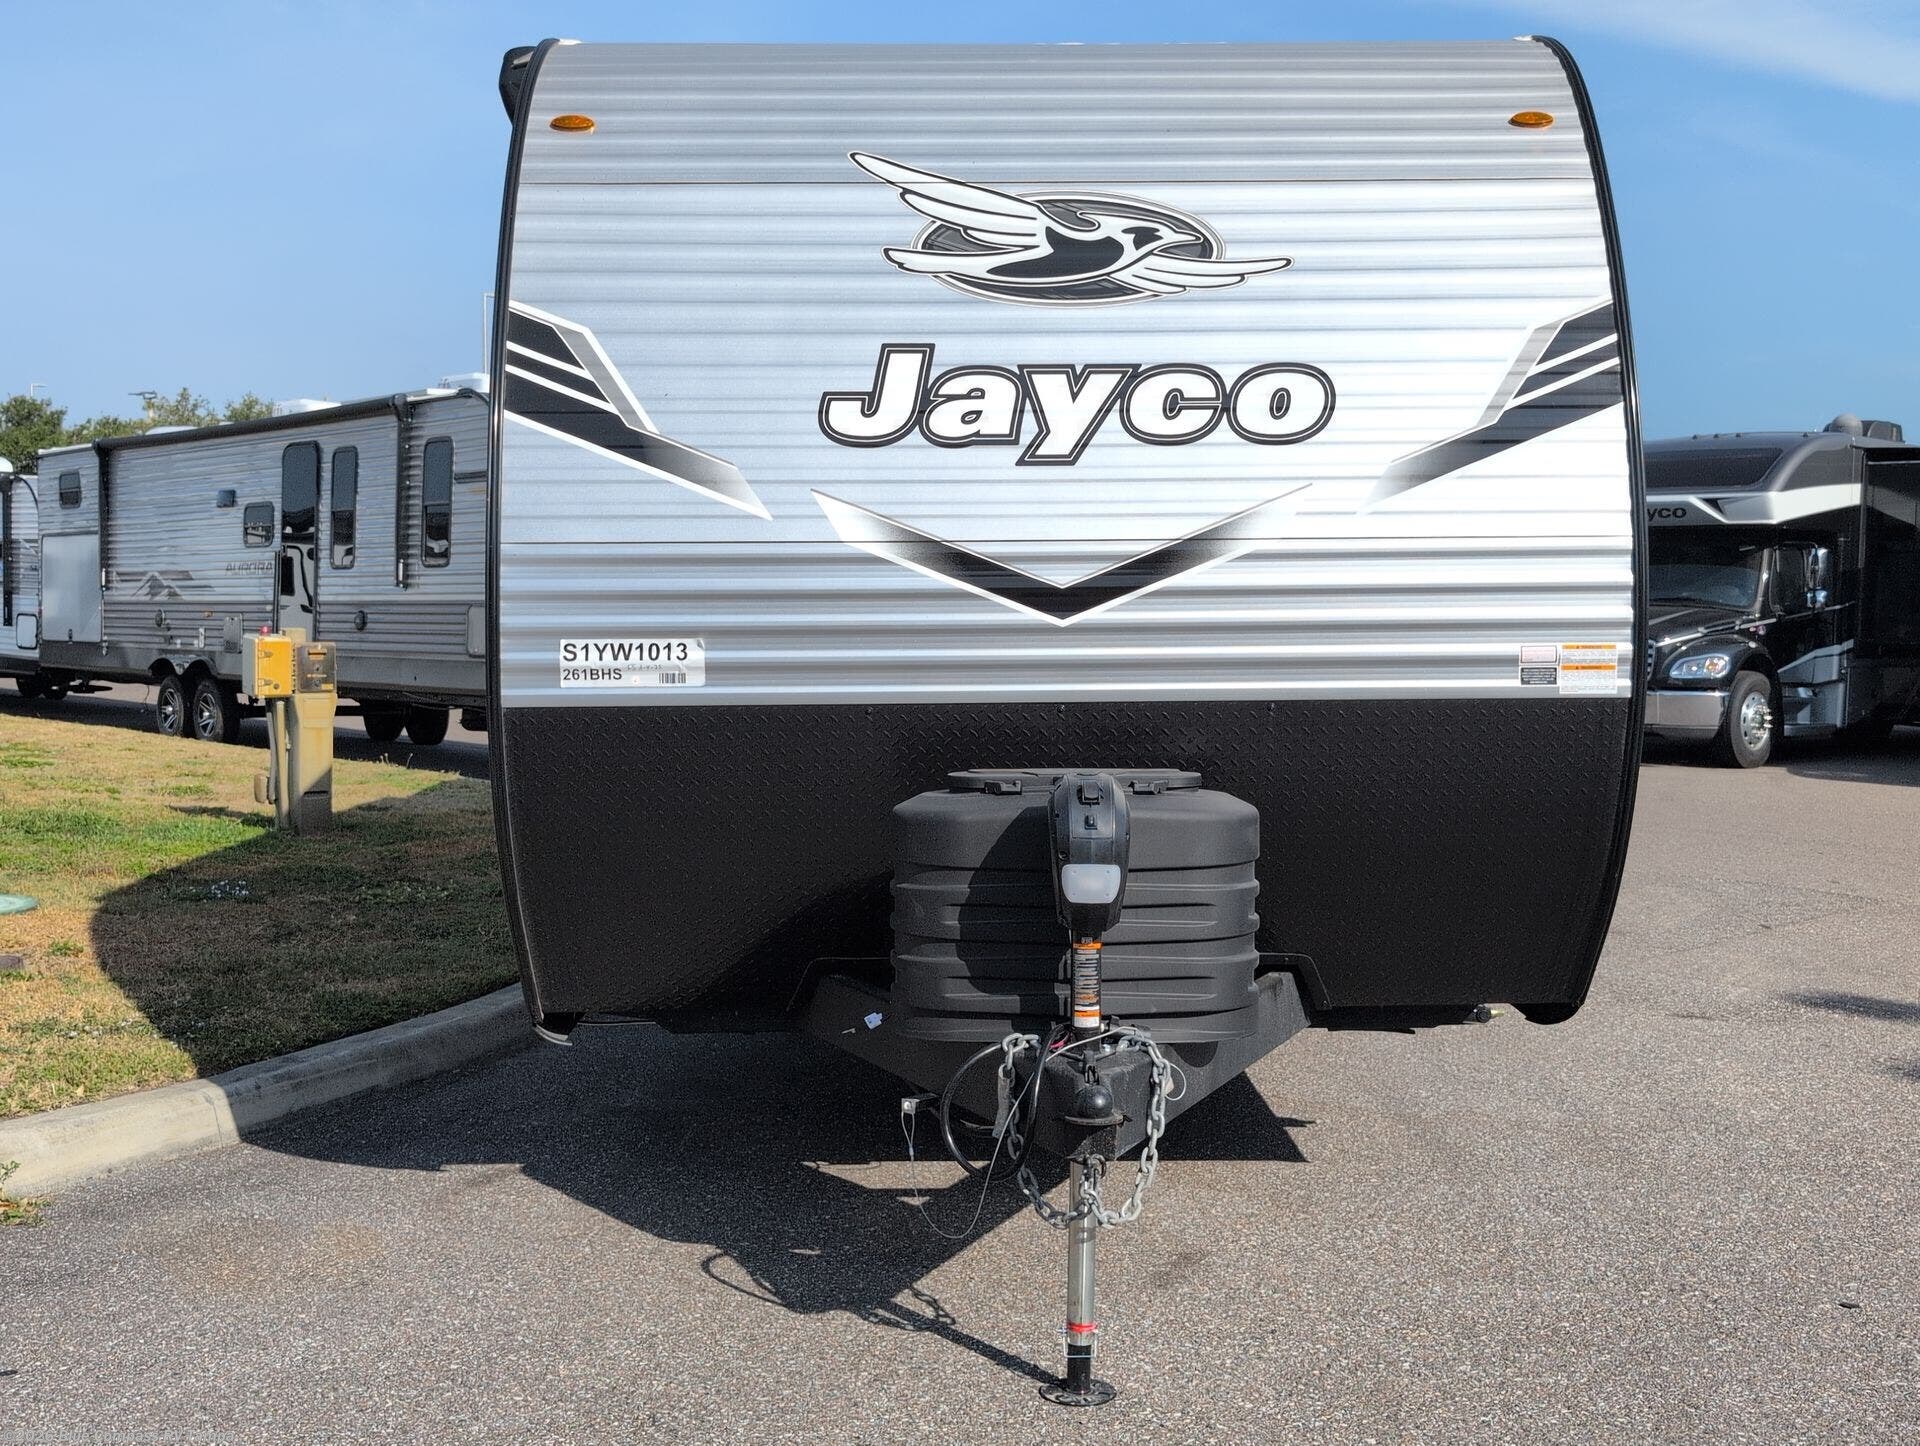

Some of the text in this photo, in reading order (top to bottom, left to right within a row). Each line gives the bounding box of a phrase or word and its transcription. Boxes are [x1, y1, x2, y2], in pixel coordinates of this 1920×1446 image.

[818, 342, 1337, 467] Jayco
[1647, 507, 1687, 521] yco
[562, 642, 688, 662] S1YW1013
[562, 668, 622, 680] 261BHS
